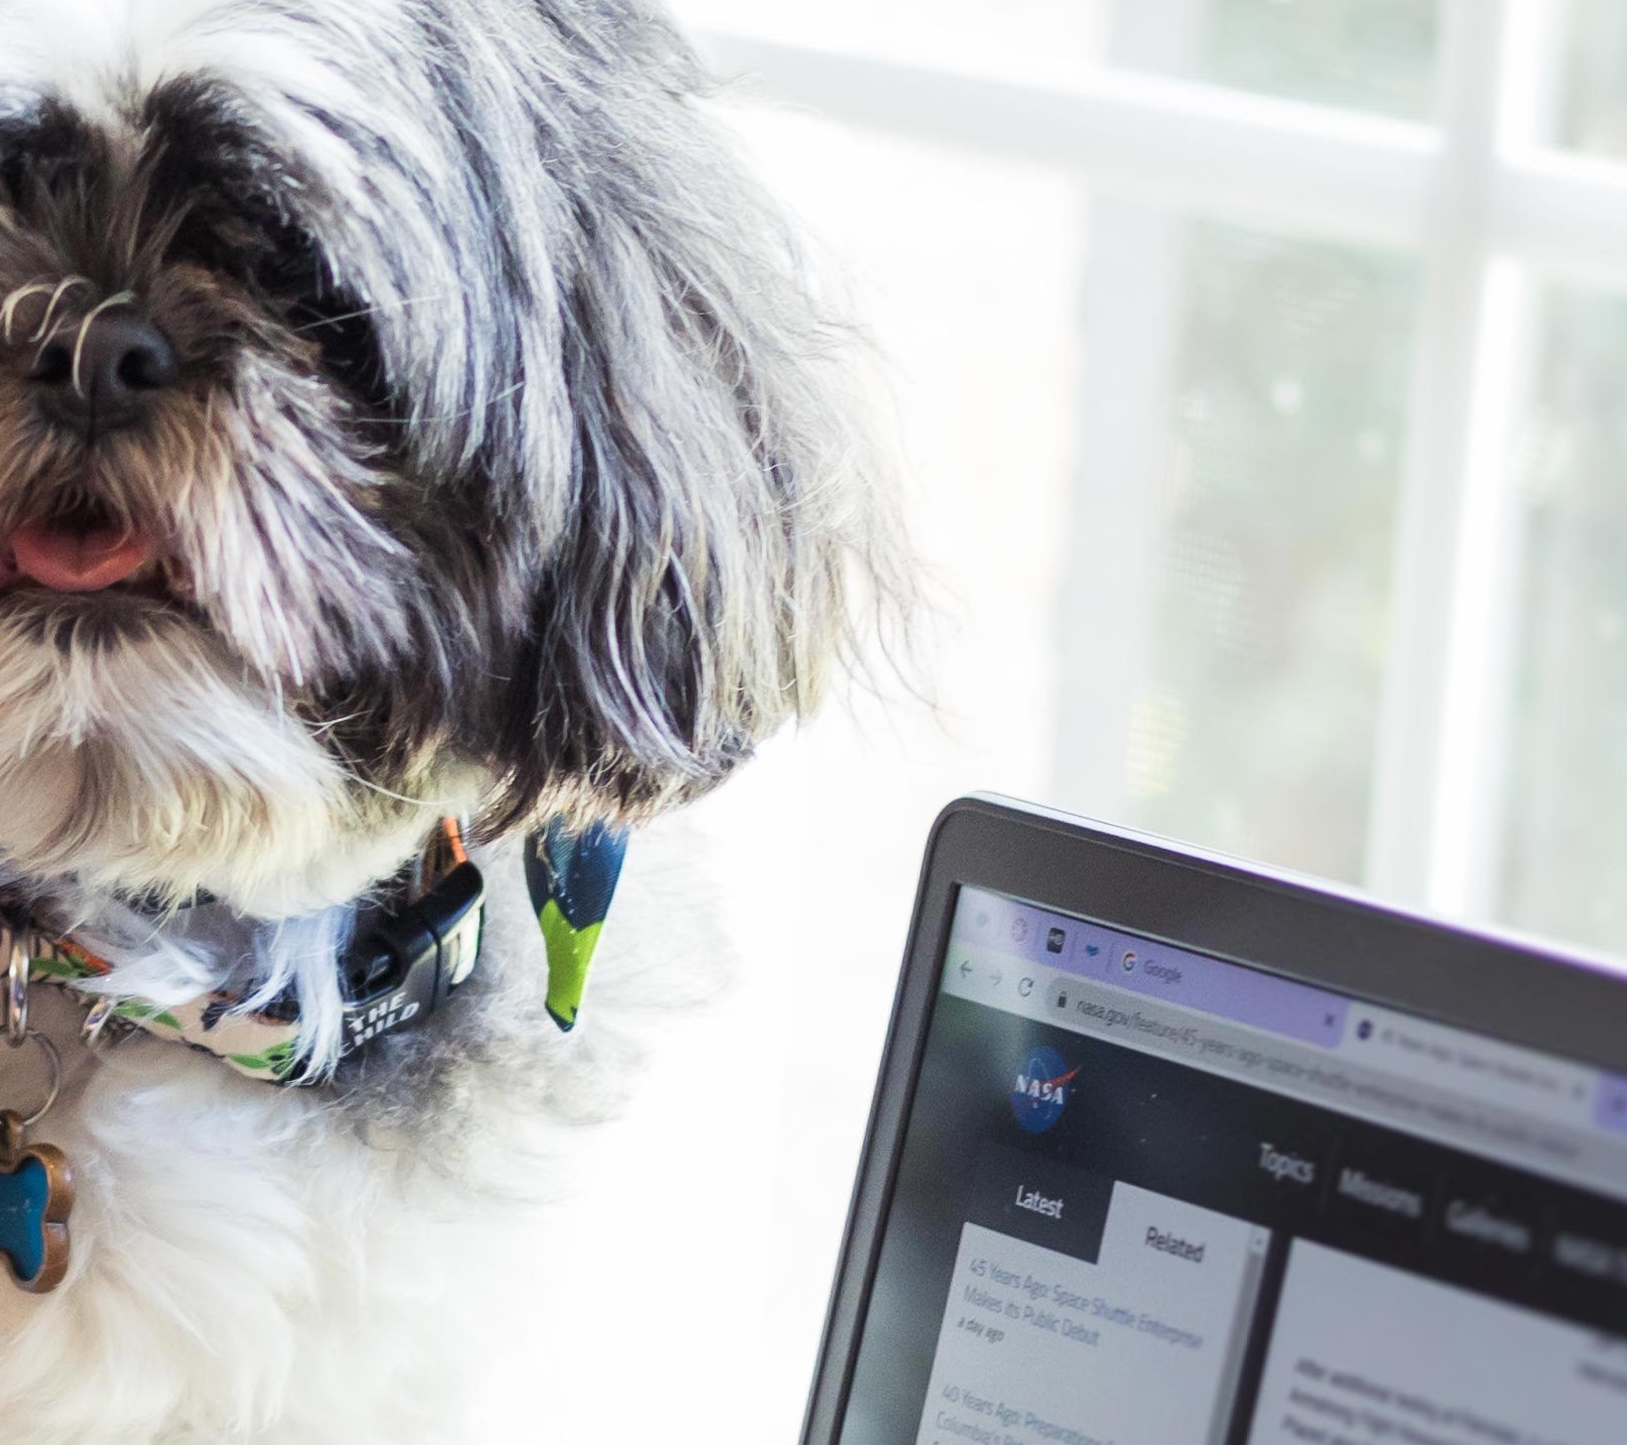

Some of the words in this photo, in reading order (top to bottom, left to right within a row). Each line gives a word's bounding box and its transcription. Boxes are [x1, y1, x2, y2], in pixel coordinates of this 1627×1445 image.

[1144, 959, 1183, 985] Google
[1015, 1074, 1064, 1105] NASA
[1259, 1141, 1315, 1186] Topics
[1338, 1167, 1423, 1218] Missions
[1015, 1185, 1064, 1219] Latest
[1144, 1226, 1205, 1264] Related
[969, 1257, 986, 1277] 45
[989, 1261, 1021, 1289] Years
[1052, 1284, 1090, 1312] Space
[963, 1284, 1002, 1313] Makes
[1023, 1304, 1060, 1334] Public
[984, 1327, 1005, 1344] ago
[963, 1391, 995, 1416] Years
